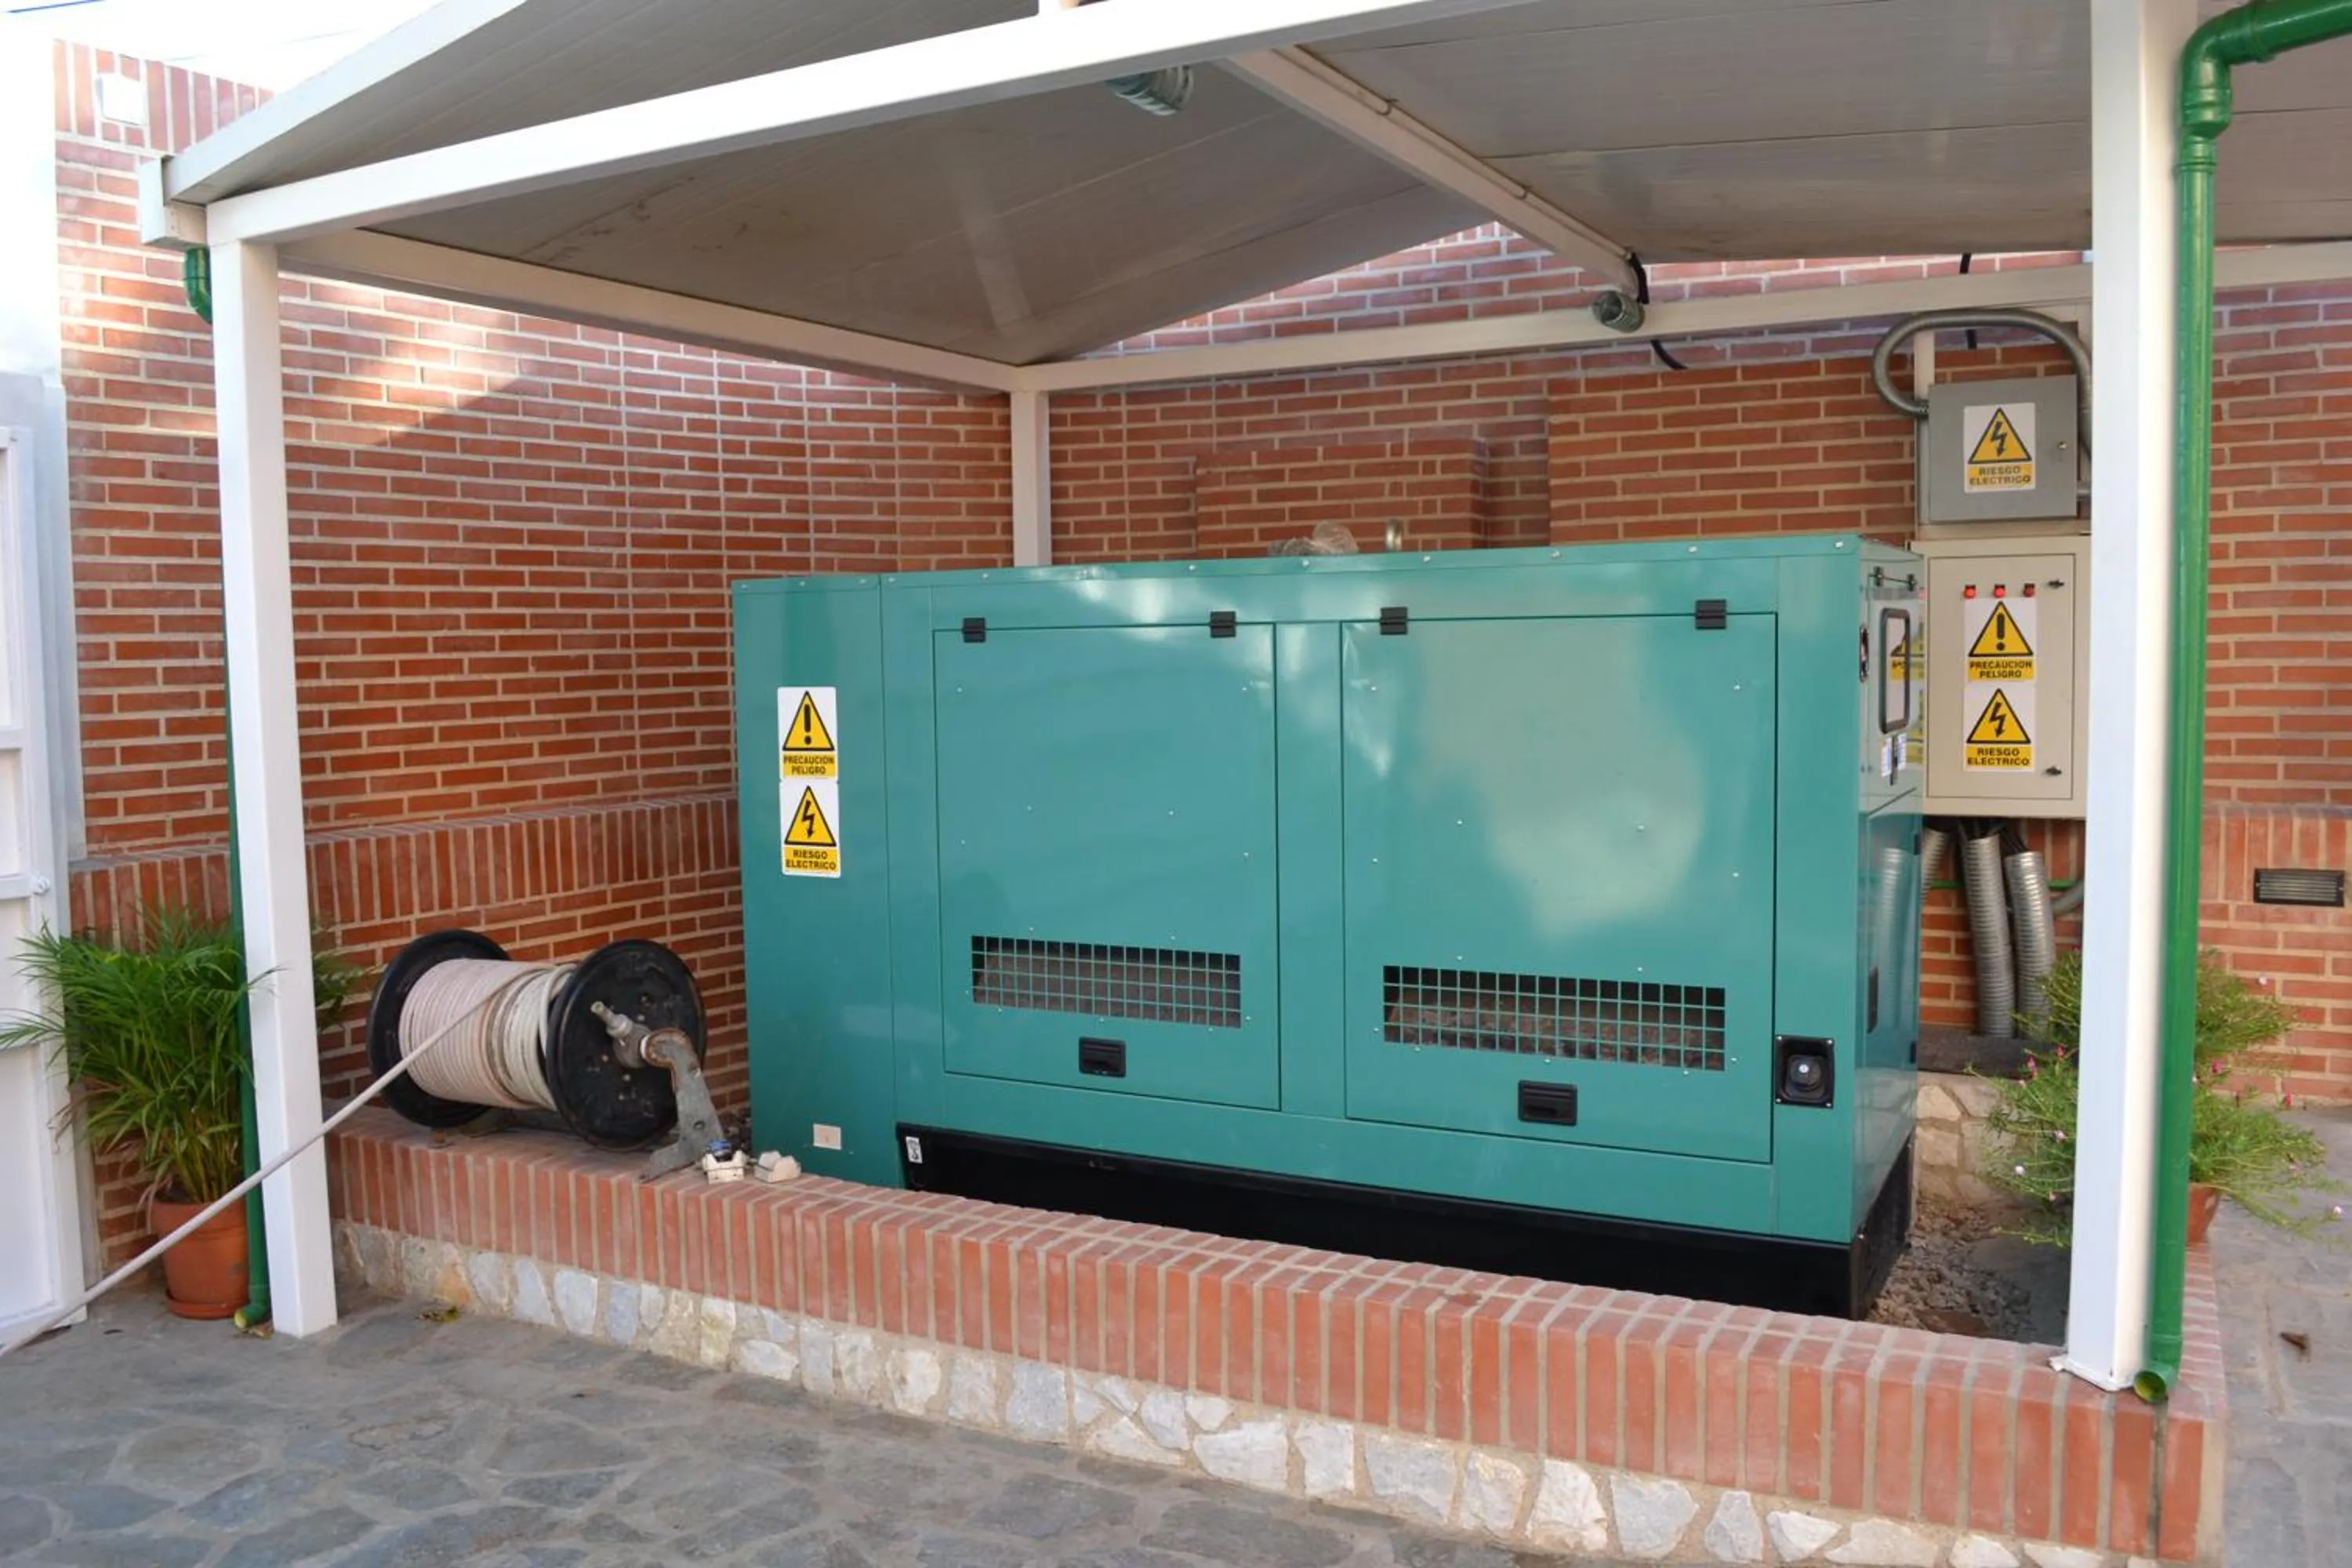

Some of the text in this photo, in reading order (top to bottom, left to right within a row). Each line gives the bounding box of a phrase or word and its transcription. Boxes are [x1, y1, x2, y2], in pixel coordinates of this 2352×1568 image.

[1978, 466, 2020, 476] RIESGO
[1980, 670, 2022, 678] PELIGRO
[1977, 747, 2020, 756] RIESGO
[1967, 757, 2030, 766] ELECTRICO
[791, 765, 826, 775] PELIGRO
[793, 850, 828, 860] RIESGO
[786, 859, 837, 870] ELECTRICO
